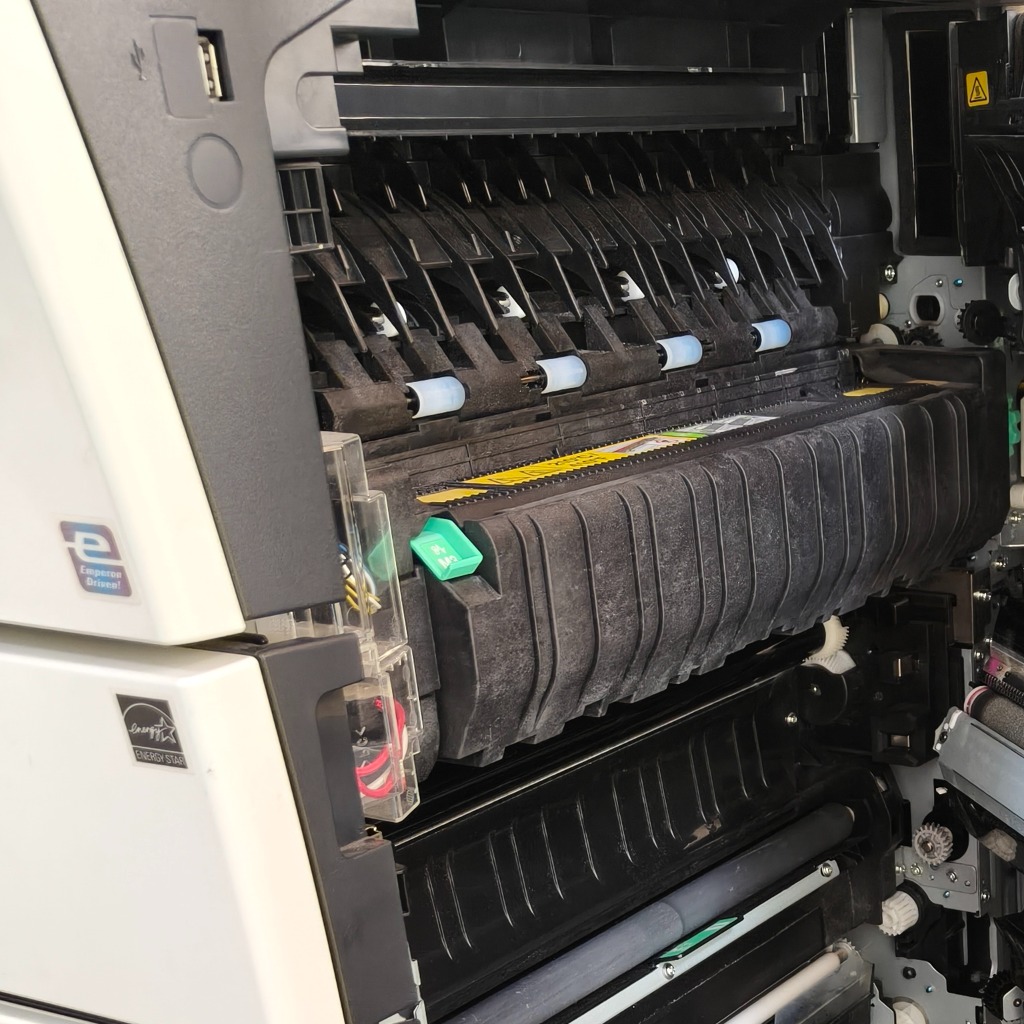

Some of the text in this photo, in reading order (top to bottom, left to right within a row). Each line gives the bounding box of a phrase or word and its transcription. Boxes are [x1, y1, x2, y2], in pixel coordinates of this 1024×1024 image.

[86, 577, 121, 590] Driven!
[135, 749, 185, 766] ENERGY STAR
